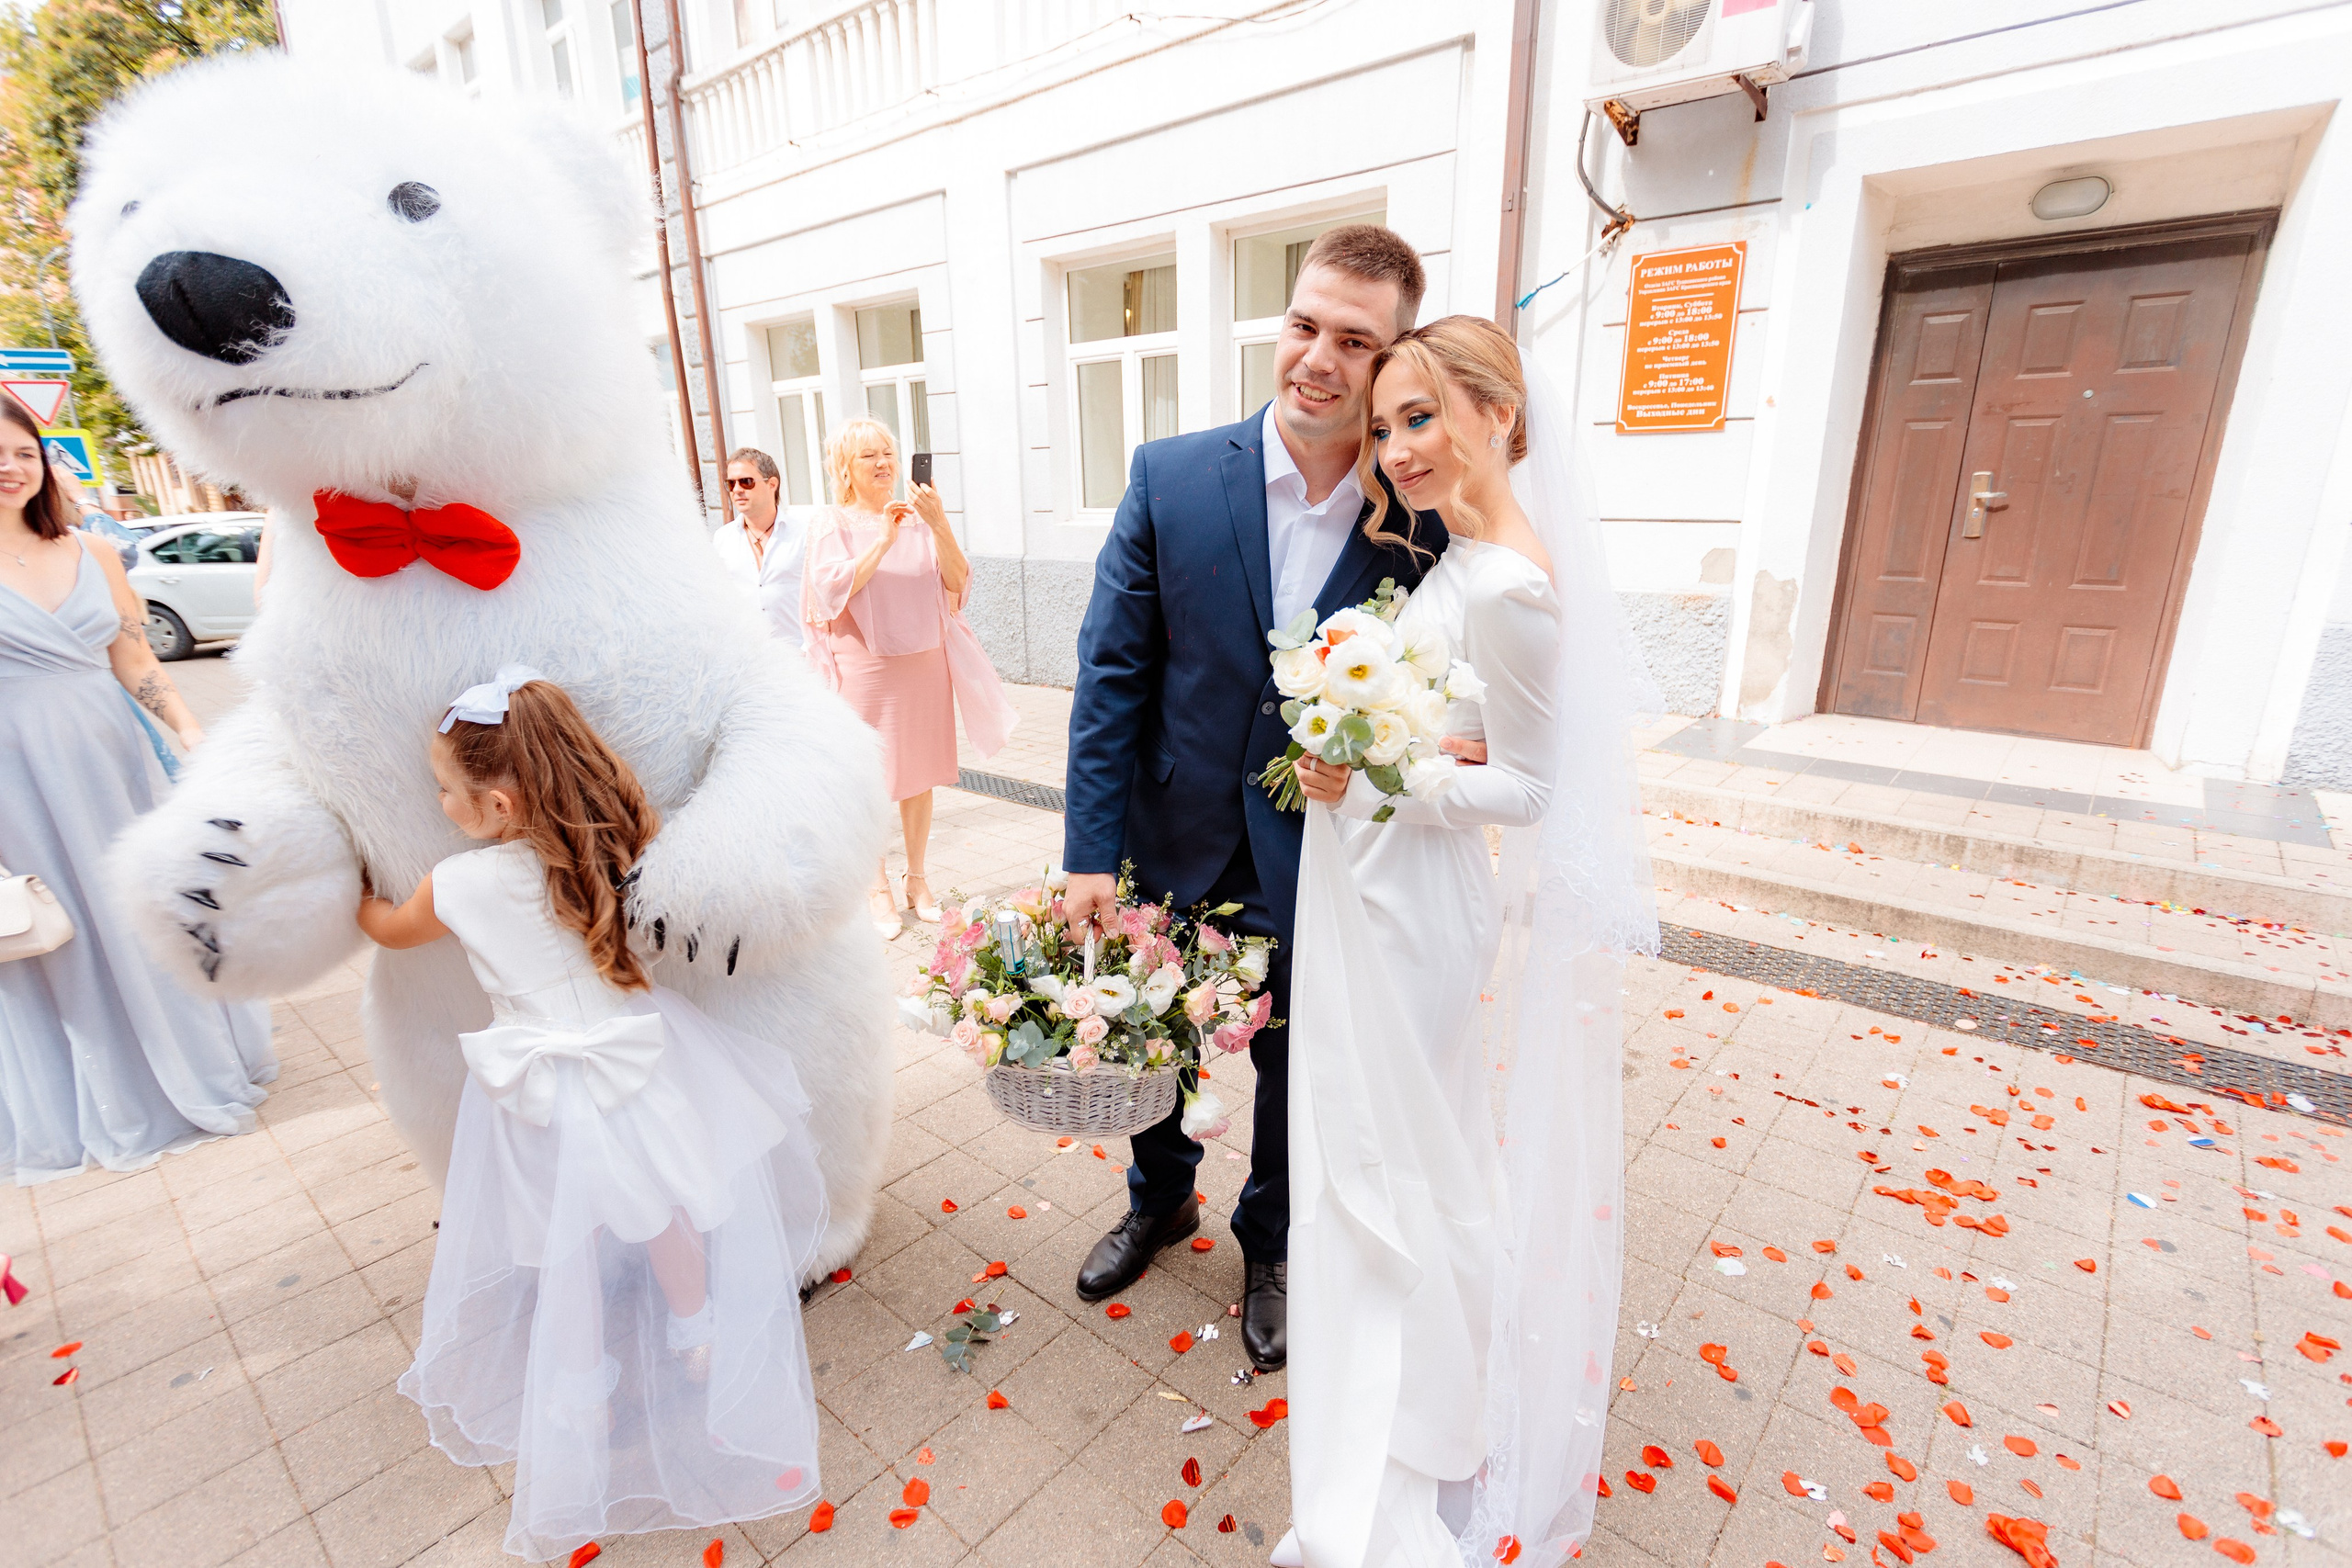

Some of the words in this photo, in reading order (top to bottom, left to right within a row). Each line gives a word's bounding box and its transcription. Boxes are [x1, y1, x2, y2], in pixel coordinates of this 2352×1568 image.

[1641, 265, 1682, 277] РЕЖИМ
[1686, 258, 1733, 271] РАБОТЫ
[1655, 310, 1676, 319] 9:00
[1687, 306, 1713, 316] 18:00
[1653, 336, 1673, 345] 9:00
[1684, 333, 1710, 342] 18:00
[1648, 379, 1668, 388] 9:00
[1679, 377, 1704, 386] 17:00
[1635, 409, 1685, 418] Выходные
